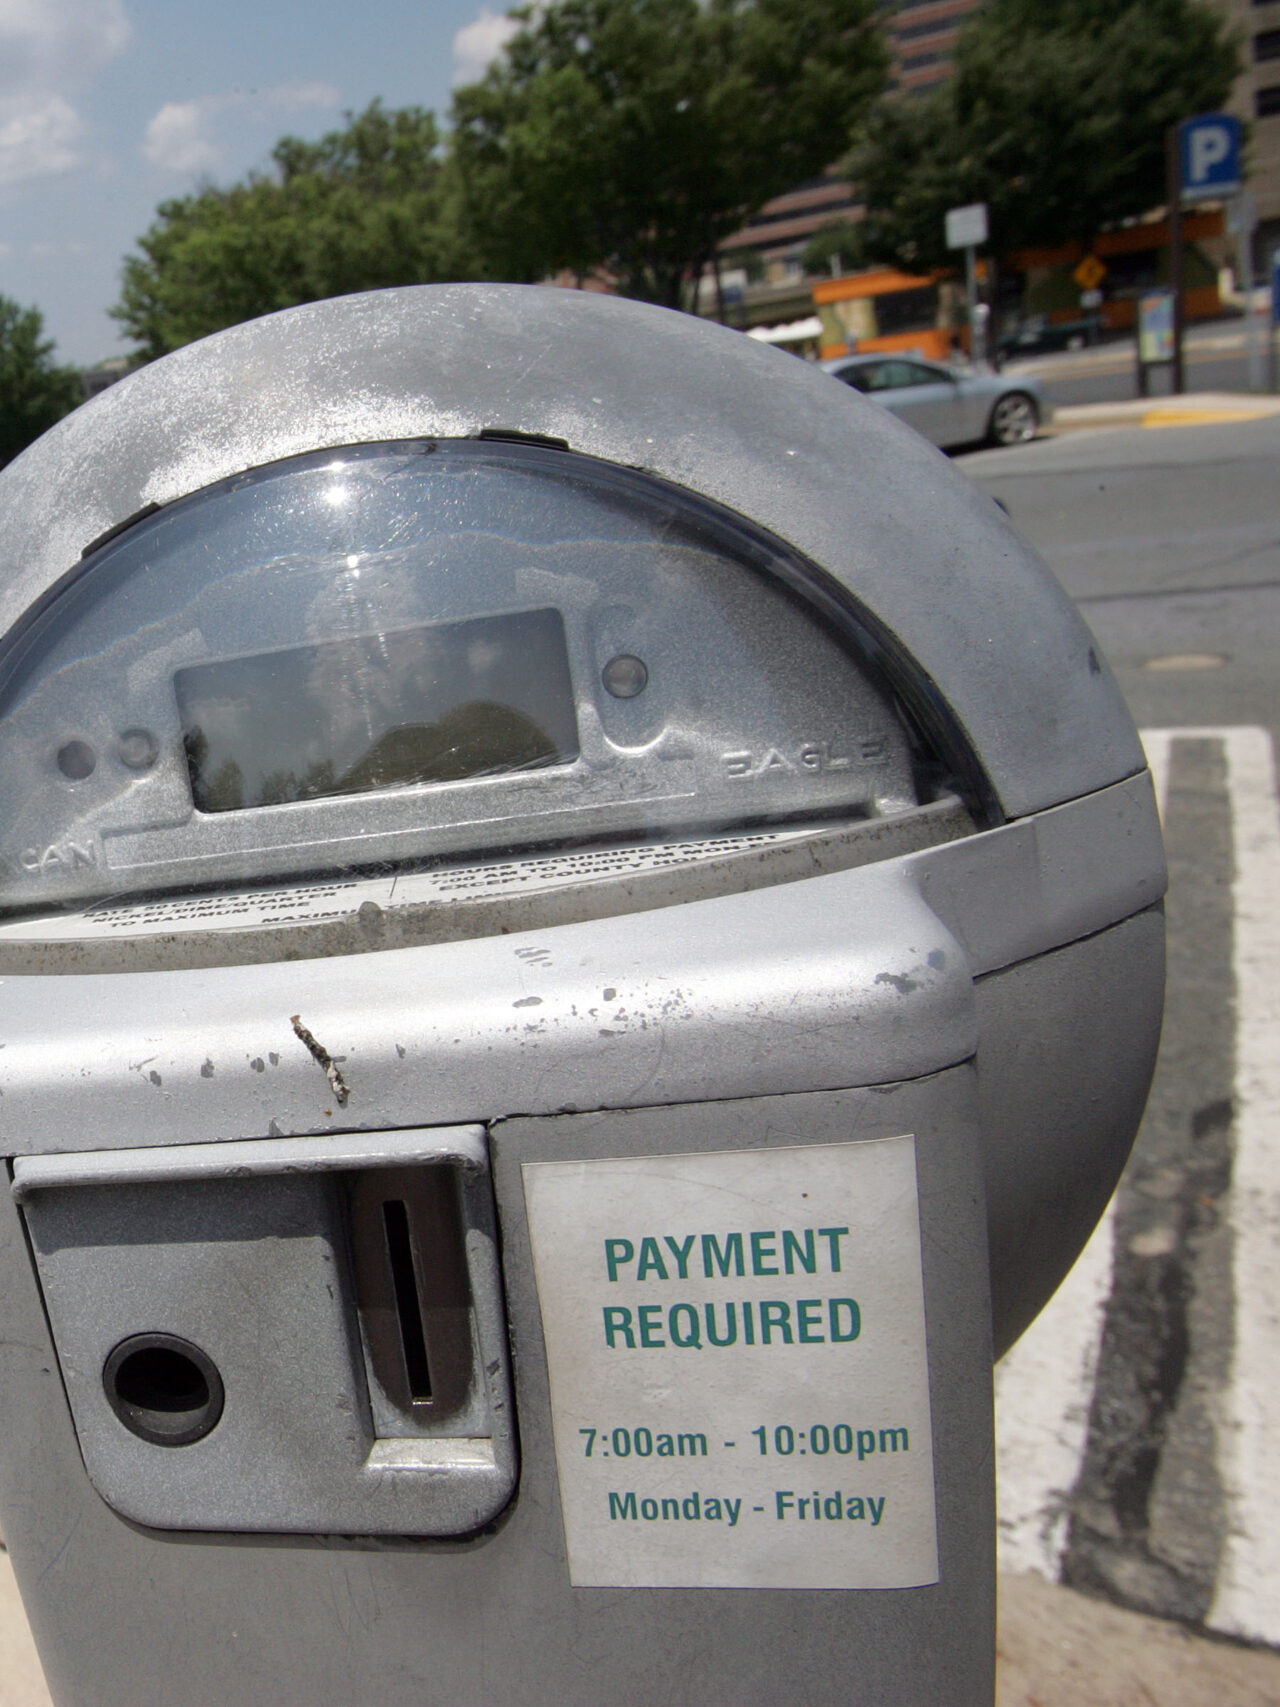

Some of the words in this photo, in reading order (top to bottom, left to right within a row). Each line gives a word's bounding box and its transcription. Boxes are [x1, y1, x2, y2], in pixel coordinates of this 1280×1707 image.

[1188, 126, 1231, 183] P
[721, 738, 888, 779] EAGLE
[429, 874, 476, 885] 7:00
[483, 870, 517, 879] AM
[526, 864, 557, 872] TO
[566, 856, 630, 867] 10:00
[638, 851, 674, 860] PM
[432, 864, 513, 878] HOURS
[520, 846, 654, 867] REQUIRING
[662, 834, 779, 850] PAYMENT
[438, 875, 531, 891] EXCEPT
[539, 861, 643, 878] COUNTY
[171, 896, 239, 907] CENTS
[246, 890, 288, 899] PER
[294, 883, 358, 894] HOUR
[110, 920, 136, 928] TO
[142, 907, 249, 924] MAXIMUM
[255, 900, 311, 911] TIME
[261, 908, 358, 923] MAXIMU
[605, 1227, 849, 1282] PAYMENT
[603, 1298, 861, 1350] REQUIRED
[579, 1427, 707, 1457] 7:00am
[752, 1424, 909, 1461] 10:00pm
[608, 1492, 741, 1526] Monday
[775, 1491, 886, 1526] Friday
